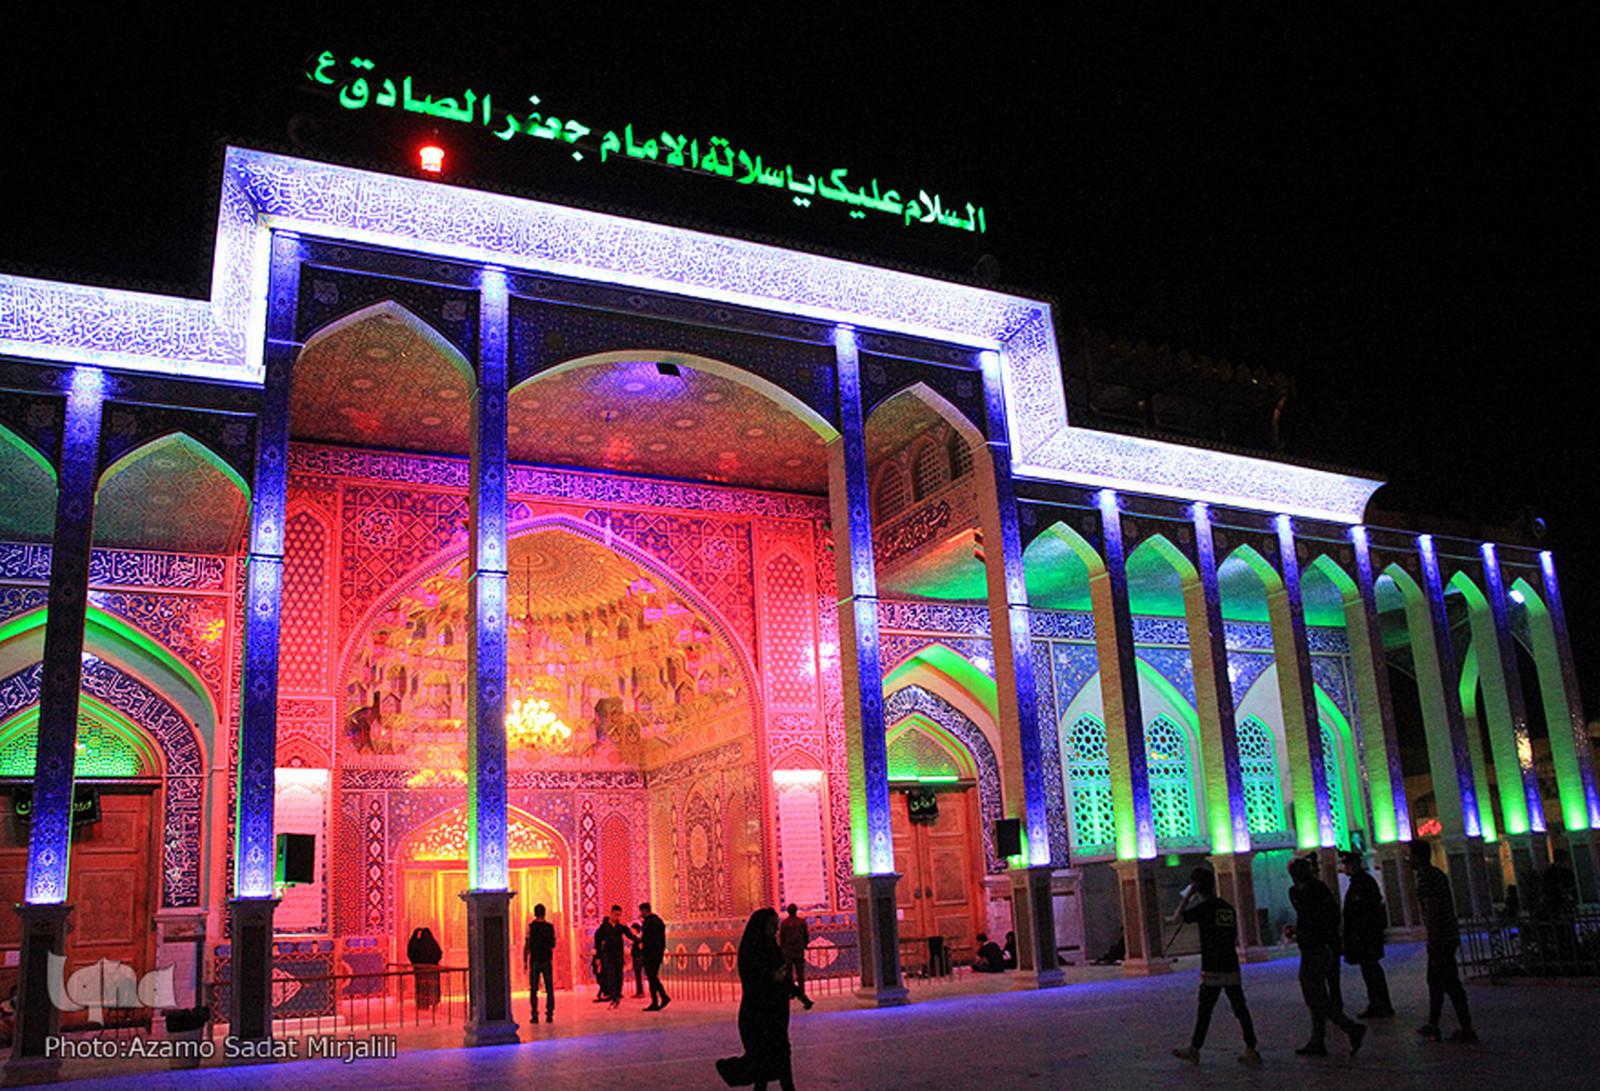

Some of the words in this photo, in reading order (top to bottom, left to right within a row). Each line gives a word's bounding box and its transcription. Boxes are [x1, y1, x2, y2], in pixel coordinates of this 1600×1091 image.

[340, 57, 492, 126] الصادق
[493, 95, 591, 162] جعفر
[905, 190, 987, 234] السلام
